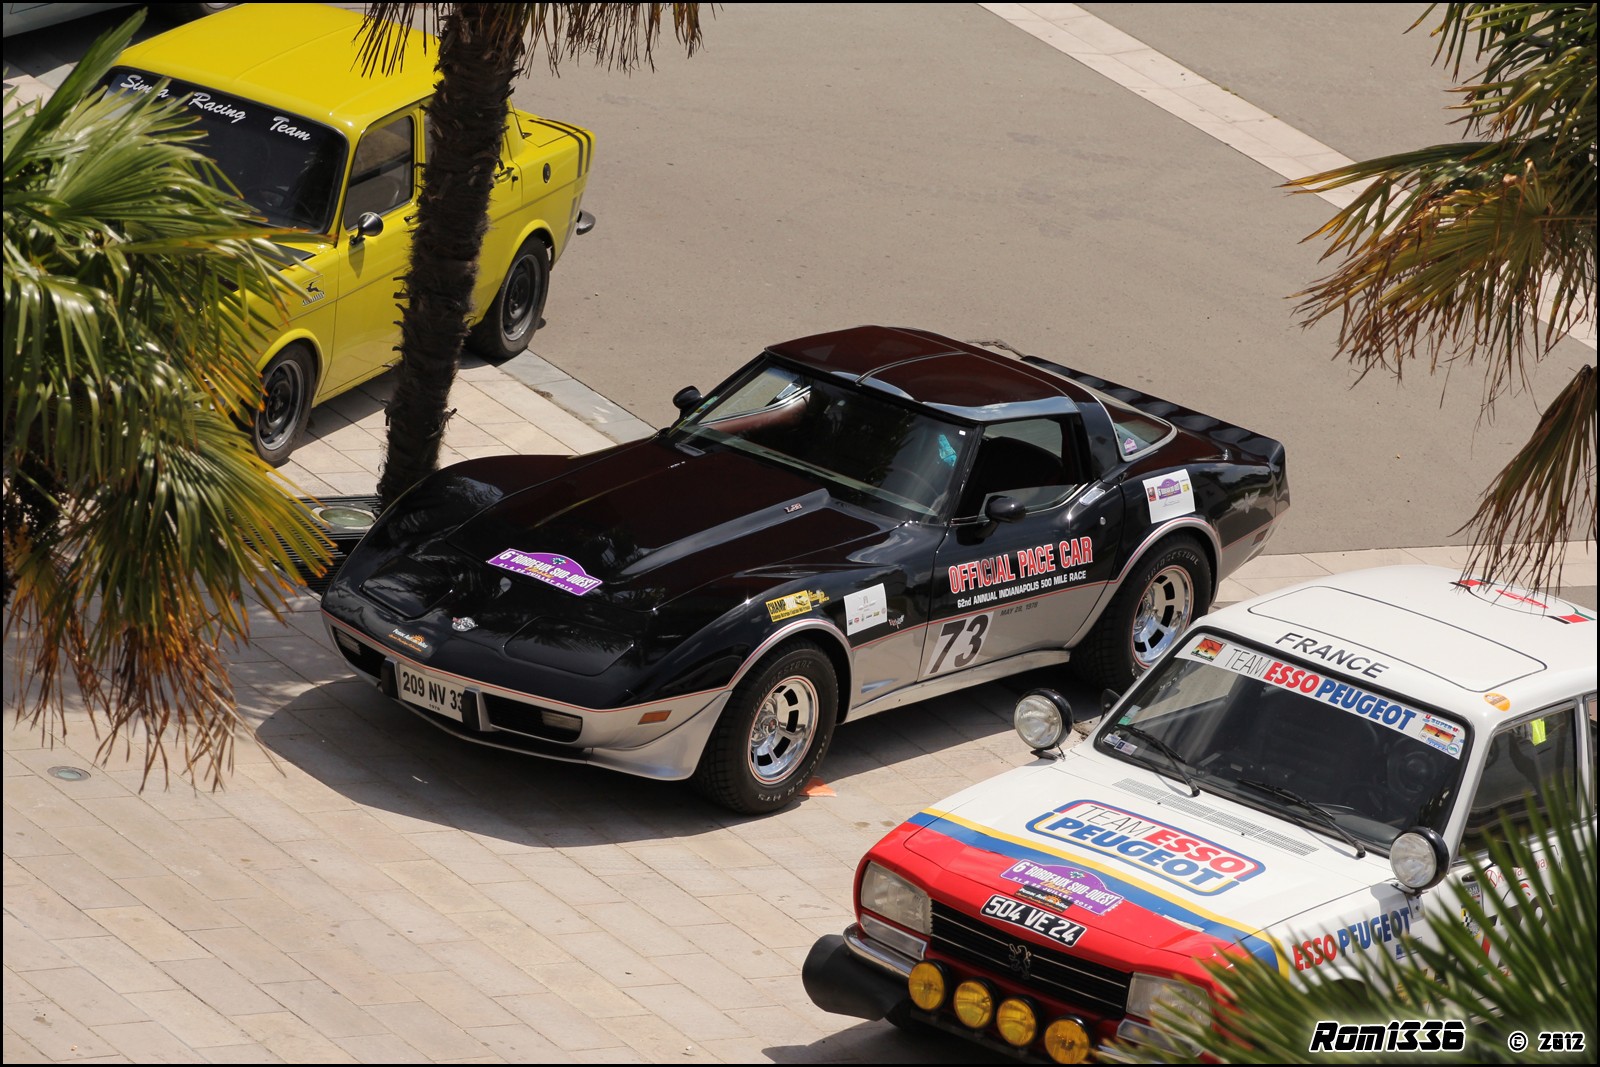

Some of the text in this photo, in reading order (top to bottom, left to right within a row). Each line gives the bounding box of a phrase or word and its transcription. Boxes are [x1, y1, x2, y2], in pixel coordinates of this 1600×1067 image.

[120, 75, 311, 141] Sima Racing Team
[510, 554, 555, 573] BORDEAUX
[550, 568, 599, 589] SUD-OUEST
[949, 536, 1093, 594] OFFICIAL PACE CAR
[957, 570, 1087, 609] 62nd ANNUAL INDIANAPOLIS 500 MILE RACE
[1000, 608, 1014, 617] MAY
[929, 614, 989, 675] 73
[1274, 632, 1389, 679] FRANCE
[403, 671, 425, 697] 209
[428, 681, 446, 706] NV
[1224, 648, 1417, 730] TEAM ESSO PEUGEOT
[1045, 817, 1225, 886] PEUGEOT
[1076, 805, 1248, 873] TEAM ESSO
[1024, 865, 1073, 888] BORDEAUX
[1067, 881, 1121, 906] SUD-OUEST
[1042, 886, 1073, 900] JUILLET
[984, 897, 1026, 922] 504
[1024, 909, 1055, 932] VE
[1048, 920, 1080, 943] 24
[1292, 934, 1338, 972] ESSO
[1337, 906, 1411, 957] PEUGEOT
